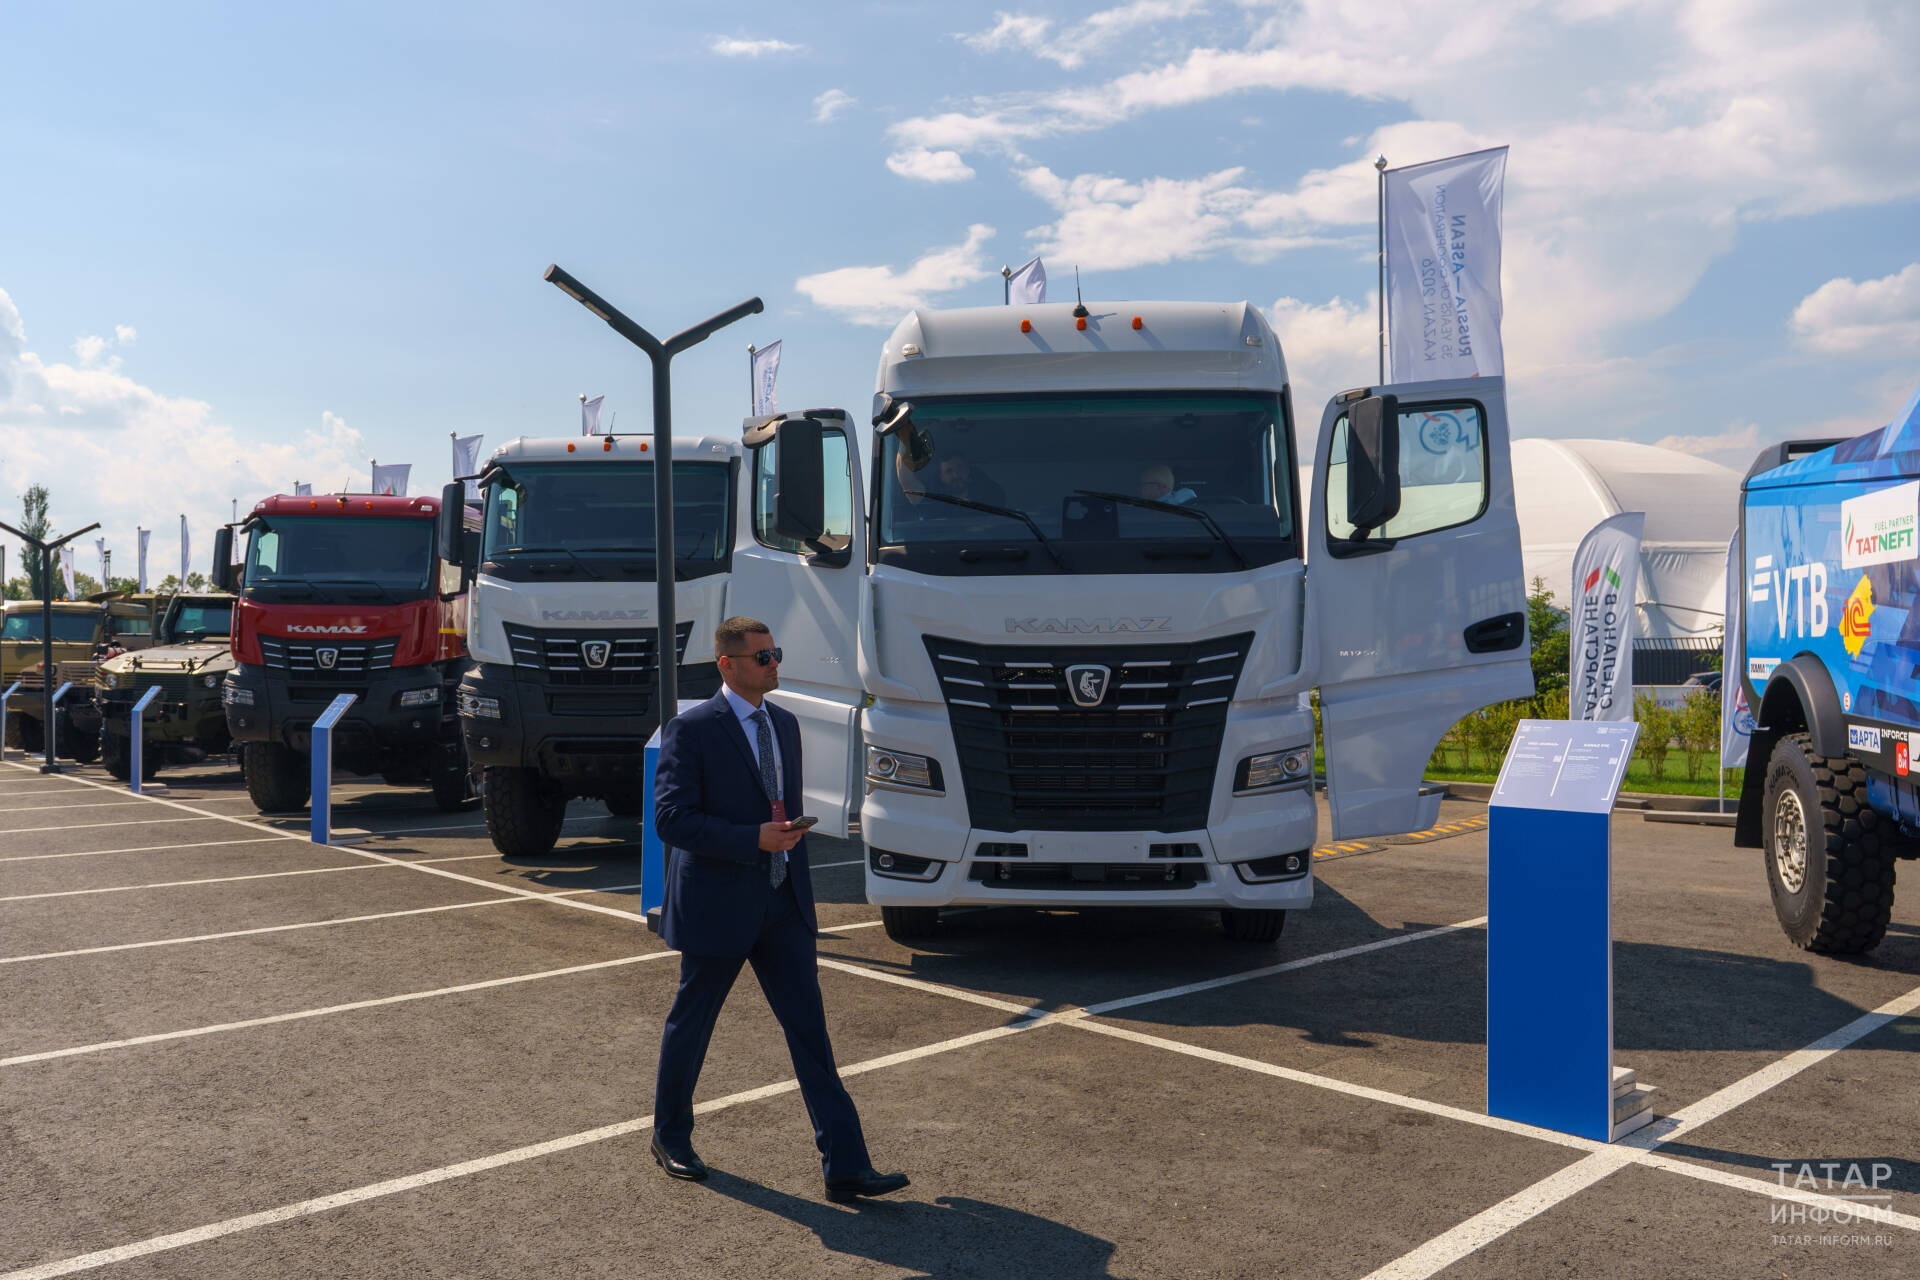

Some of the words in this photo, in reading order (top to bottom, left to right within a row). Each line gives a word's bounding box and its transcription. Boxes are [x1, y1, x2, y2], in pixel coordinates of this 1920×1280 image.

[1889, 514, 1913, 528] PARTNER
[1856, 528, 1913, 555] TATNEFT
[1773, 562, 1828, 639] VTB
[542, 609, 649, 620] KAMAZ
[287, 624, 368, 633] KAMAZ
[1005, 616, 1172, 633] KAMAZ
[1881, 728, 1908, 741] INFORCE
